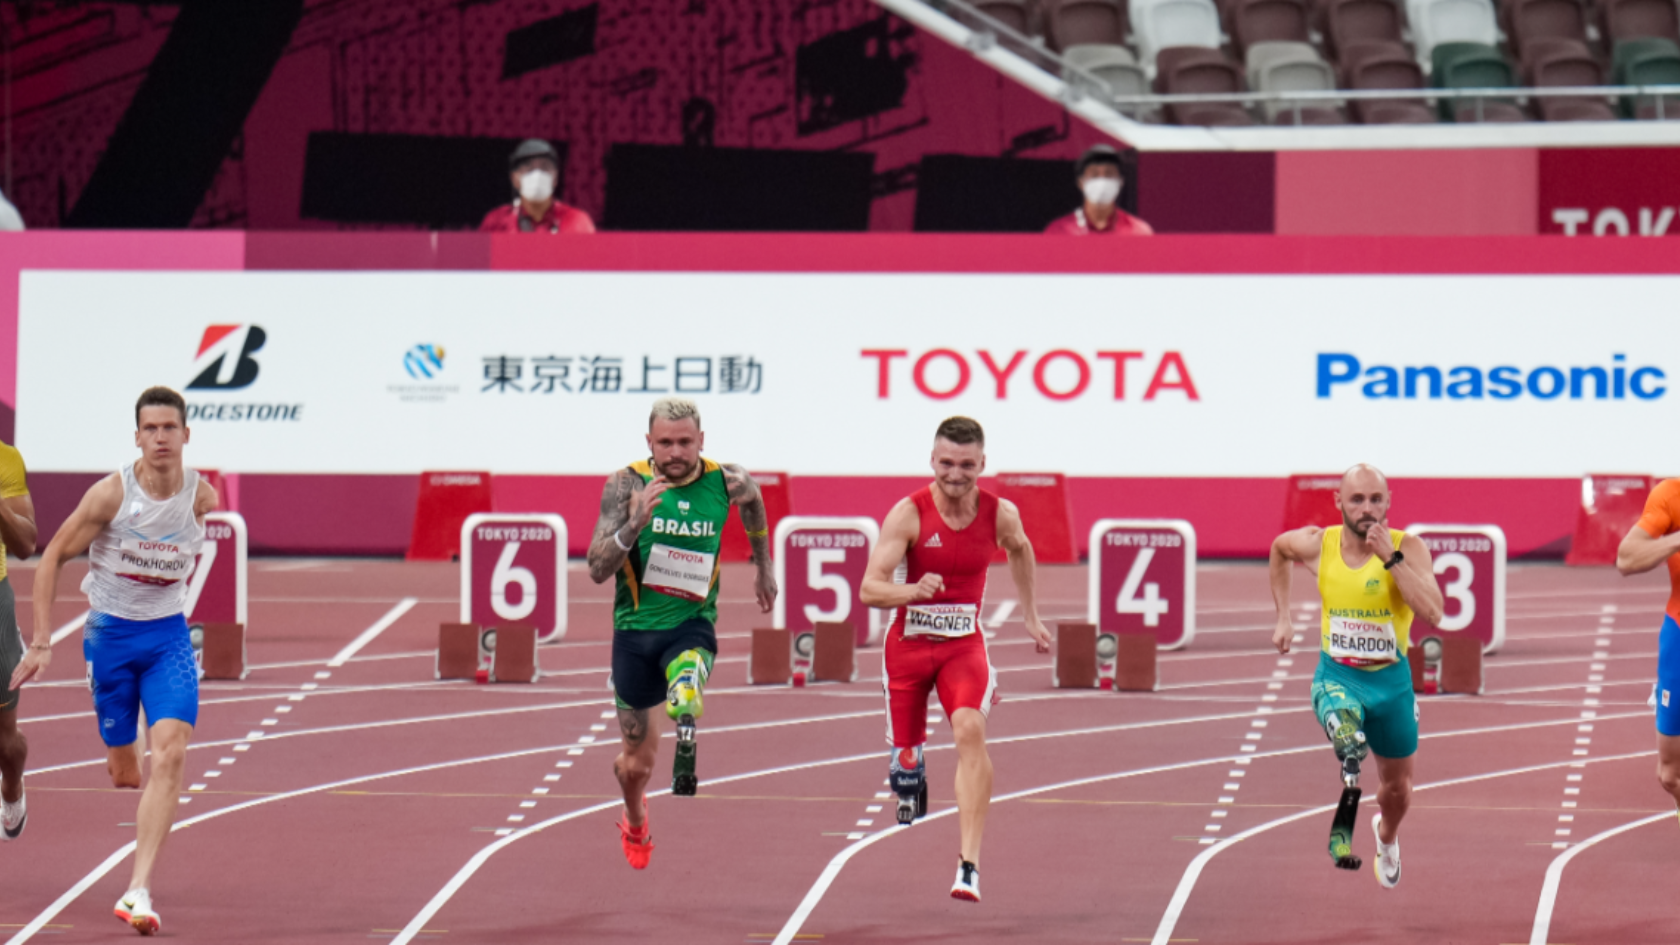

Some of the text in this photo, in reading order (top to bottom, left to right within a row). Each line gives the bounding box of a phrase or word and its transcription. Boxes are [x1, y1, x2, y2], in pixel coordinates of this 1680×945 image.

[1552, 207, 1680, 236] TOK
[481, 354, 763, 394] 東京海上日動
[860, 348, 1201, 401] TOYOTA
[1316, 352, 1668, 400] Panasonic
[185, 403, 303, 421] DGESTONE
[206, 525, 232, 540] 020
[477, 527, 553, 541] TOKYO 2020
[652, 516, 716, 537] BRASIL
[138, 541, 180, 553] TOYOTA
[790, 533, 866, 548] TOKYO 2020
[1106, 532, 1182, 548] TOKYO 2020
[1424, 537, 1491, 552] OKYO 2020
[121, 553, 187, 571] PROKHOROV
[667, 549, 705, 564] TOYOTA
[183, 539, 218, 619] 7
[490, 540, 537, 621] 6
[803, 547, 852, 624] 5
[1115, 546, 1169, 627] 4
[1432, 551, 1477, 632] 3
[924, 606, 964, 614] OYOTA
[1329, 608, 1391, 618] AUSTRALIA
[910, 610, 972, 632] WAGNER
[1343, 621, 1383, 633] TOYOTA
[1331, 632, 1394, 652] REARDON
